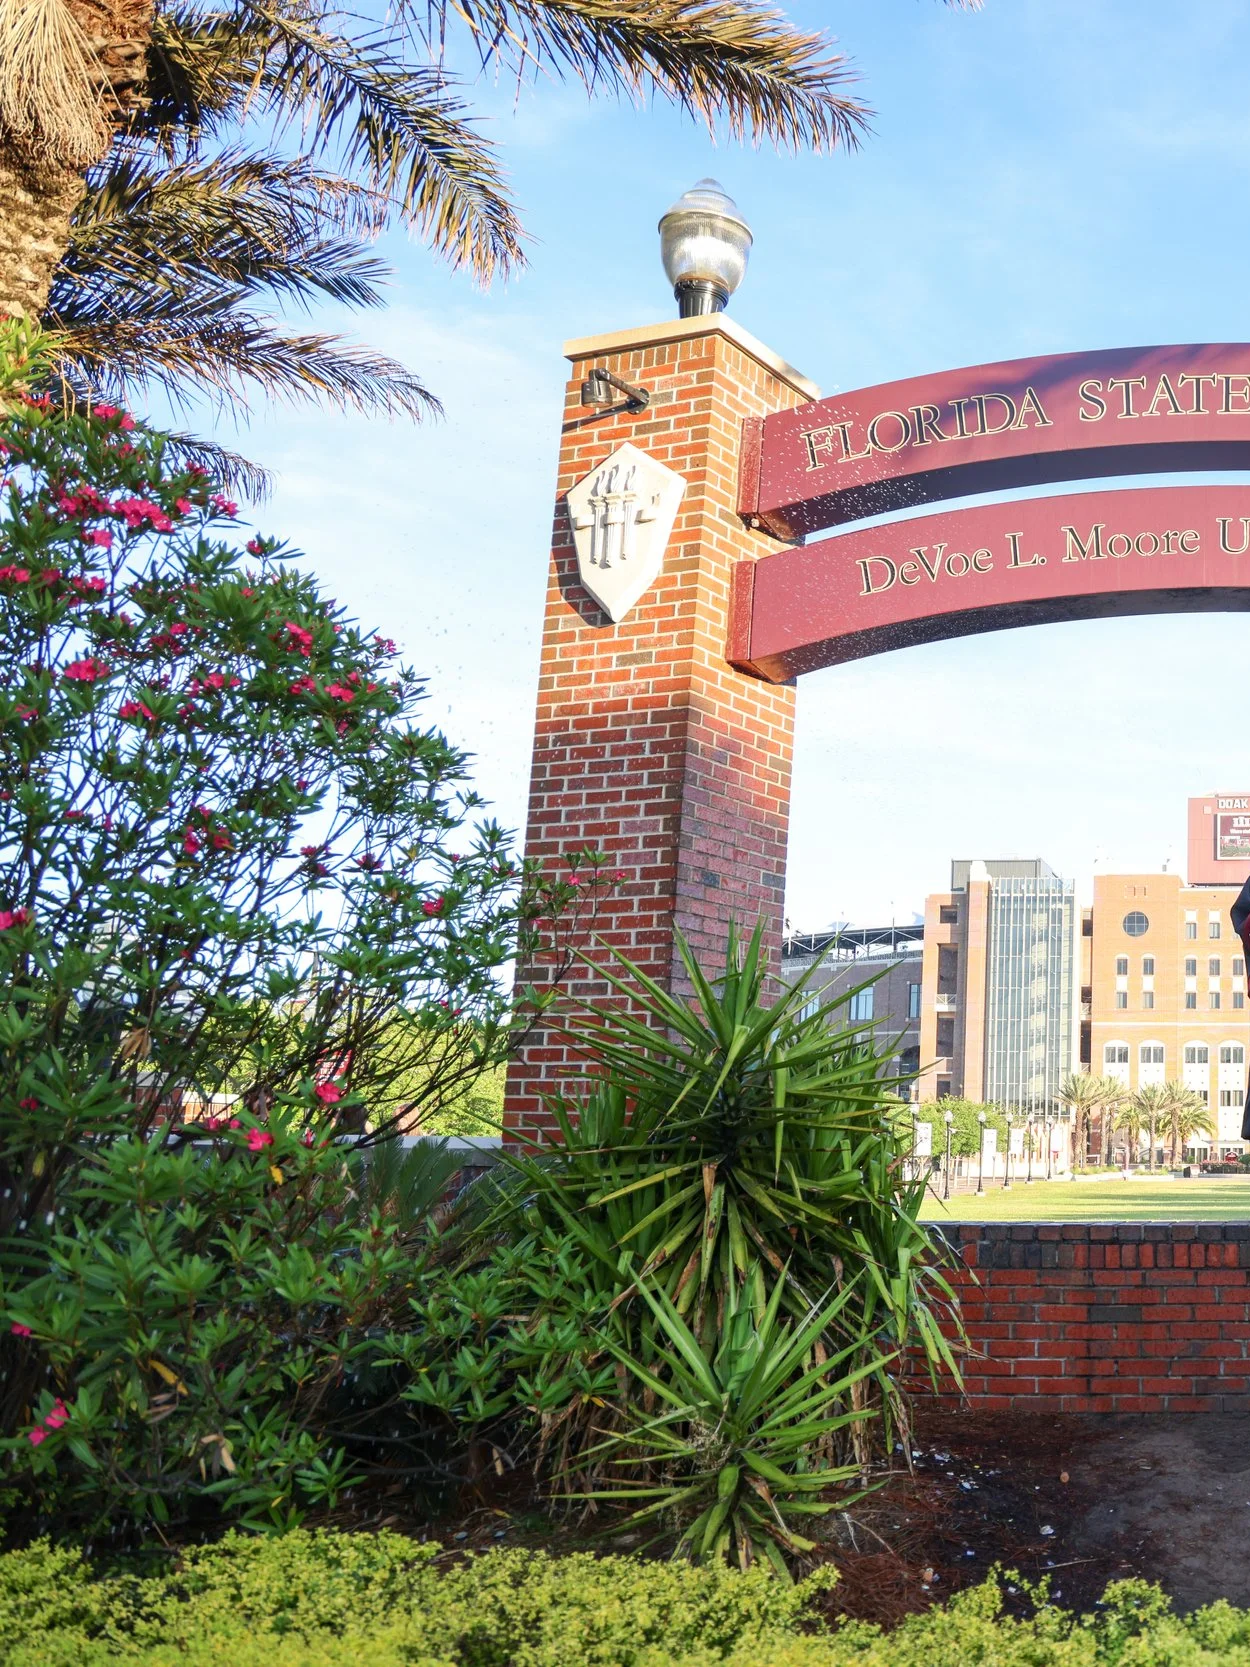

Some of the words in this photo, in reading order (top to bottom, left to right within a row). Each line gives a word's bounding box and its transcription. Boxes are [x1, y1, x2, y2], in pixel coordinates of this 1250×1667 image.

[800, 386, 1053, 472] FLORIDA
[857, 542, 993, 596] DeVoe
[1005, 532, 1047, 569] L.
[1061, 523, 1201, 562] Moore
[1218, 798, 1249, 809] DOAK
